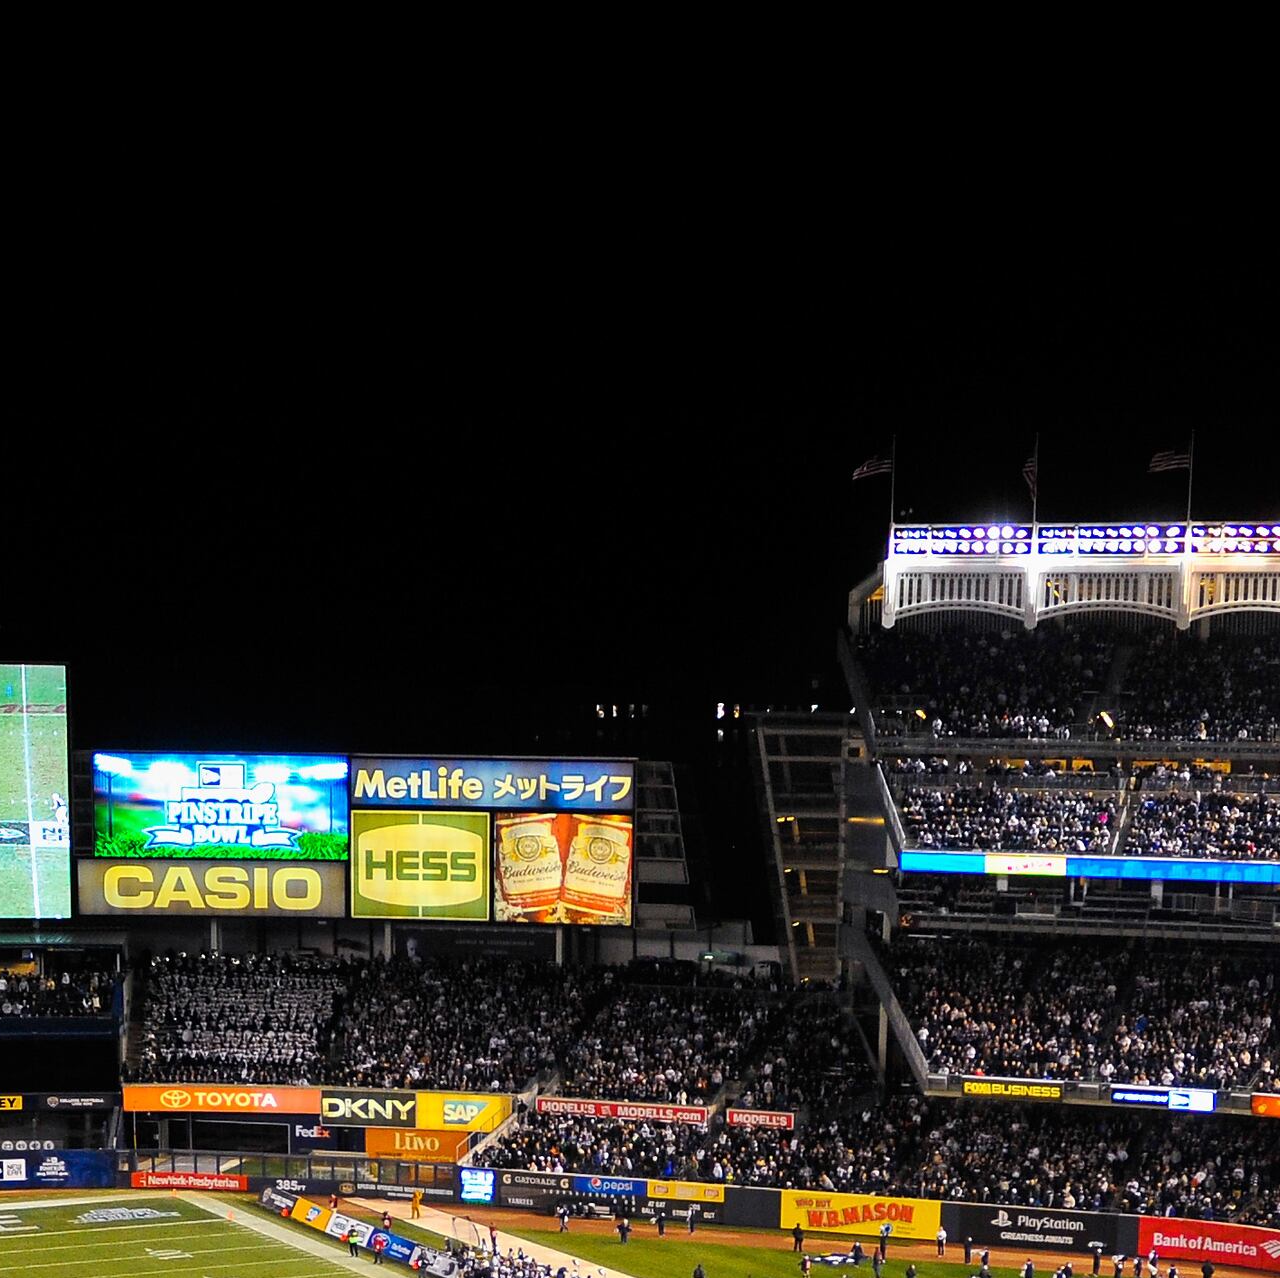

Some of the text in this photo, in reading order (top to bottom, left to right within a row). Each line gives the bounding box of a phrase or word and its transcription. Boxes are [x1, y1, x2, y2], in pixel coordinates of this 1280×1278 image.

[354, 766, 484, 799] MetLife
[493, 773, 633, 802] メットライフ
[167, 800, 280, 825] PINSTRIPE
[193, 825, 251, 844] BOWL
[365, 850, 476, 882] HESS
[103, 865, 322, 911] CASIO
[991, 1083, 1061, 1098] BUSINESS
[194, 1092, 278, 1108] TOYOTA
[322, 1097, 416, 1121] DKNY
[541, 1101, 596, 1115] MODELL'S
[443, 1102, 480, 1122] SAP
[733, 1113, 788, 1127] MODELL'S
[295, 1125, 331, 1138] FedEx
[514, 1176, 557, 1187] GATORADE
[601, 1181, 634, 1193] pepsi
[1017, 1214, 1085, 1232] PlayStation
[1000, 1231, 1044, 1242] GREATNESS
[1153, 1232, 1257, 1256] Bank of America
